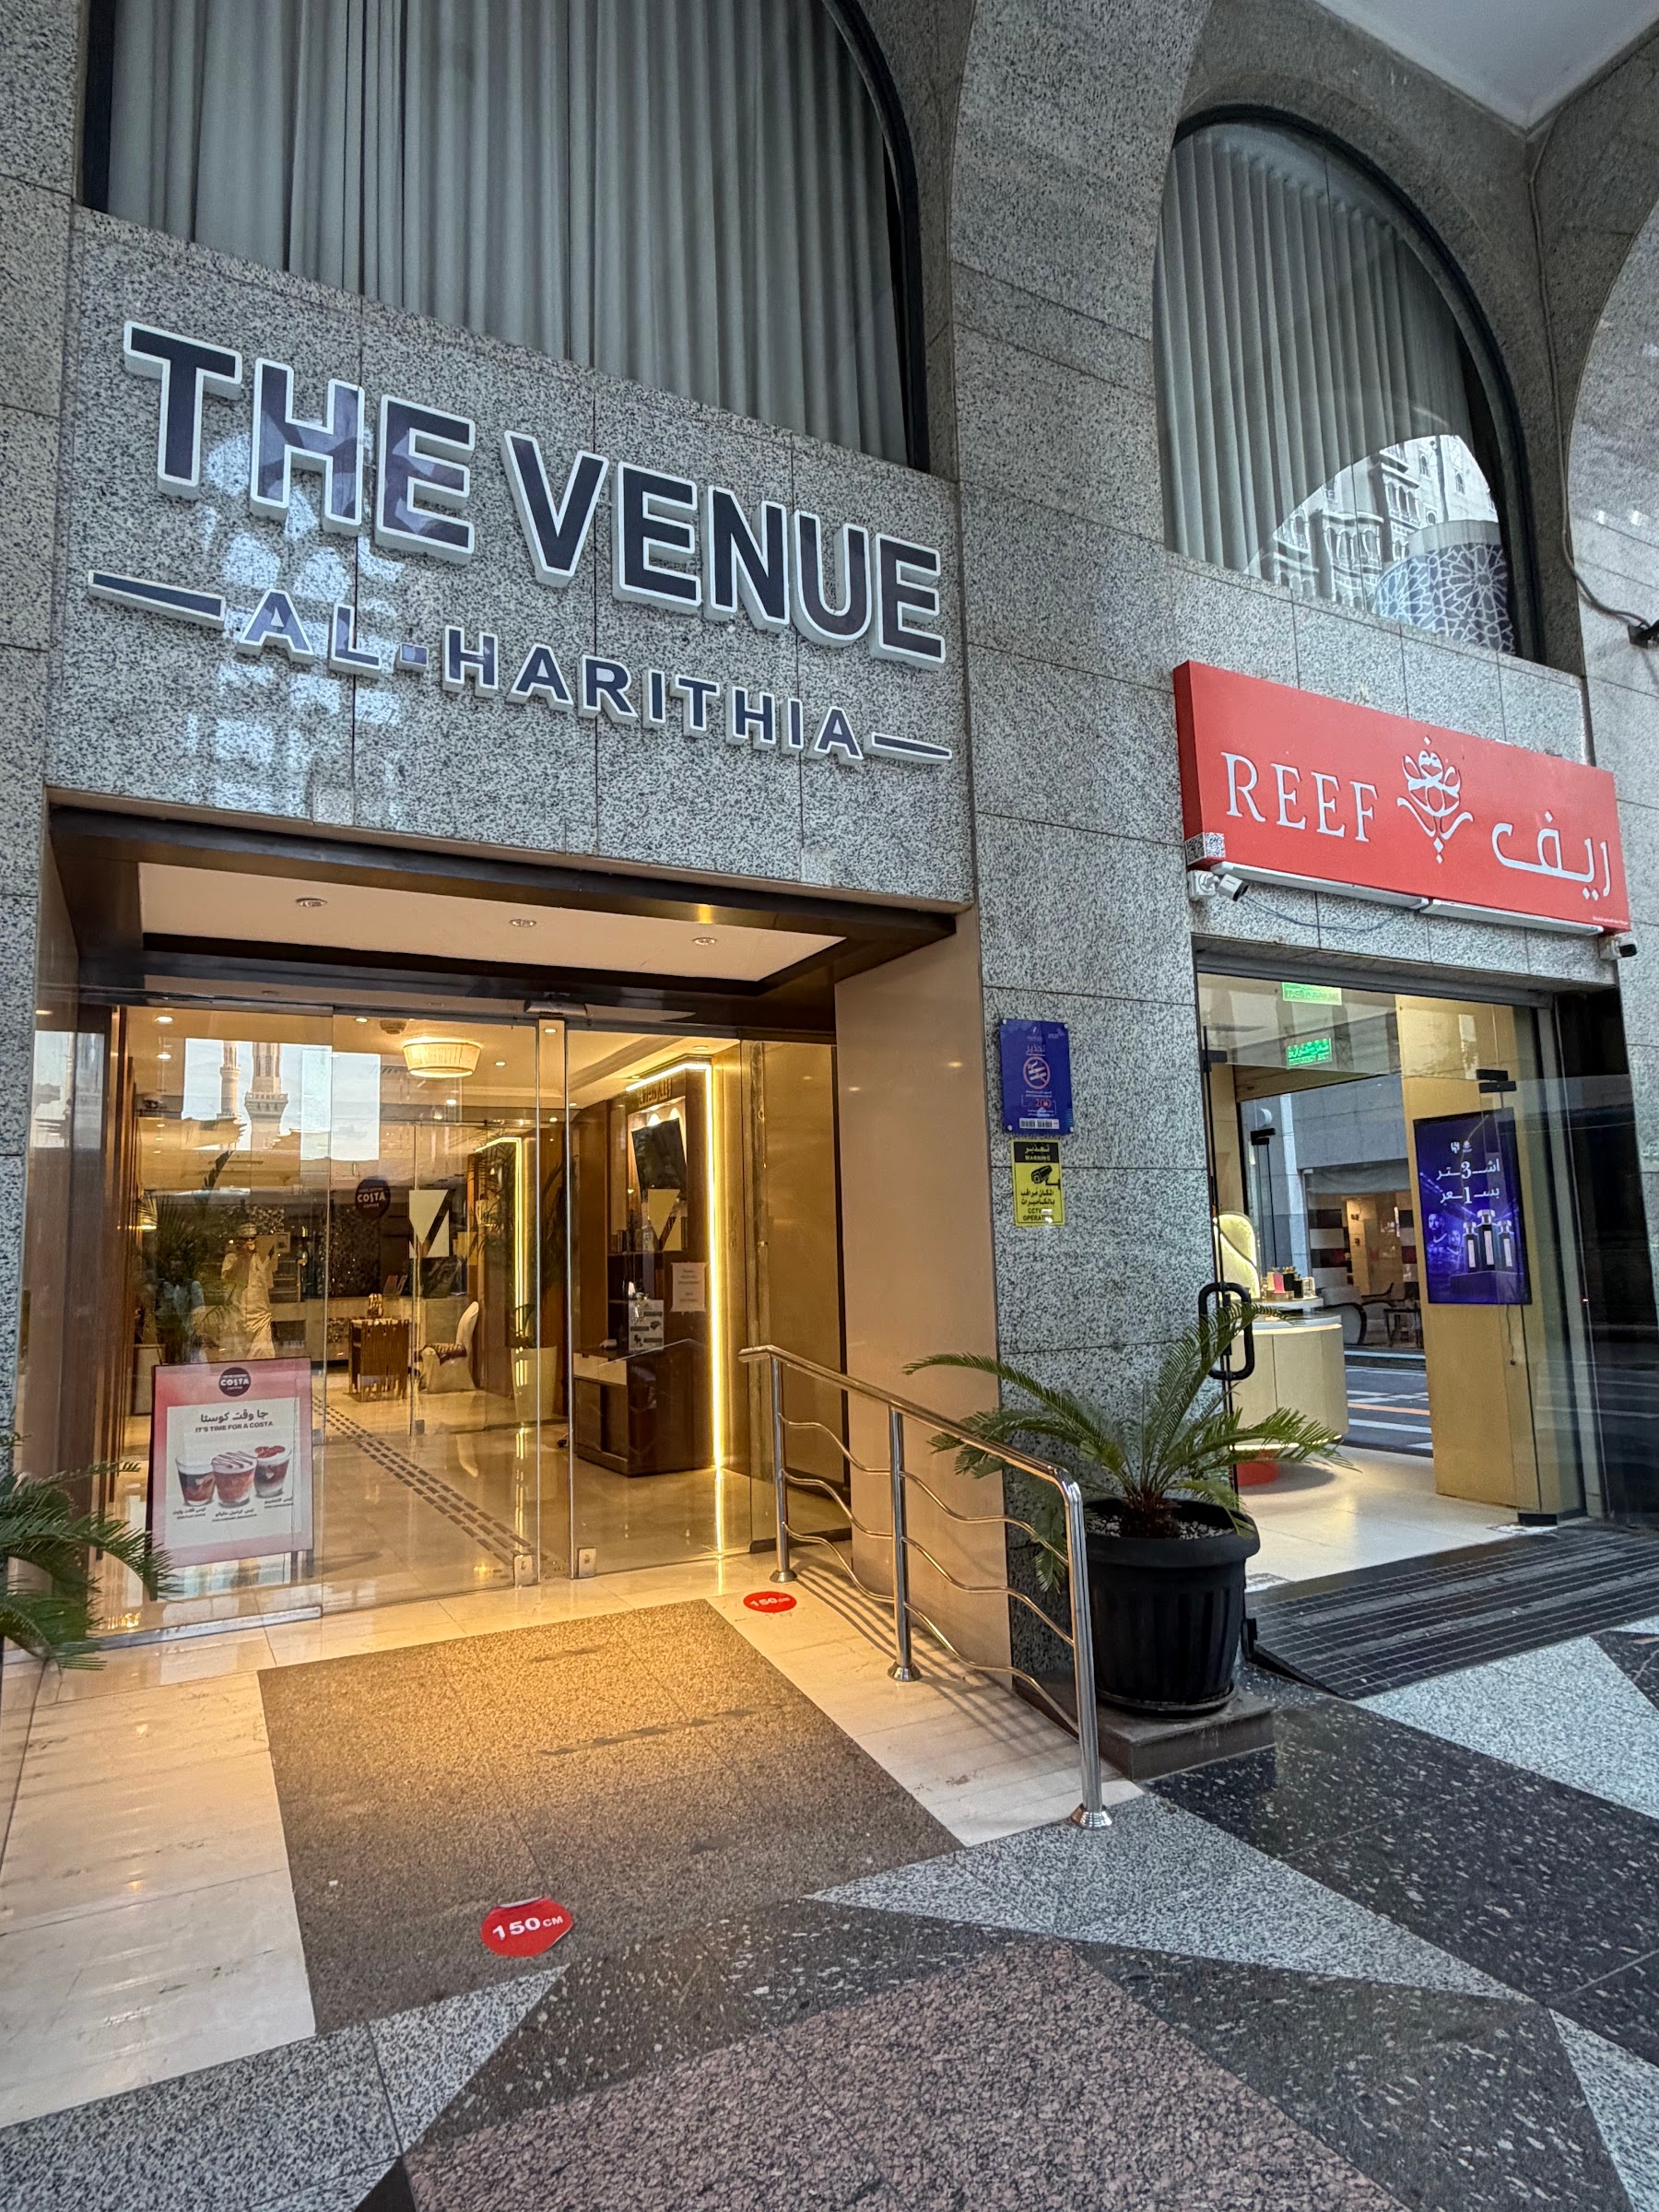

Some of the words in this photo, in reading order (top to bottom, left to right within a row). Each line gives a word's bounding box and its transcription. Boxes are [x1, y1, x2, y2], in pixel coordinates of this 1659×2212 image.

[124, 320, 475, 564] THE
[500, 429, 947, 672] VENUE
[237, 587, 865, 762] AL-HARITHIA
[1220, 750, 1379, 843] REEF
[1491, 810, 1612, 901] ريف
[357, 1192, 385, 1203] COSTA
[220, 1377, 250, 1386] COSTA
[200, 1411, 230, 1423] كوستا
[232, 1408, 254, 1421] وقت
[256, 1408, 268, 1420] جا
[209, 1424, 227, 1432] TIME
[249, 1420, 274, 1429] COSTA
[492, 1917, 541, 1941] 150
[542, 1915, 564, 1927] CM
